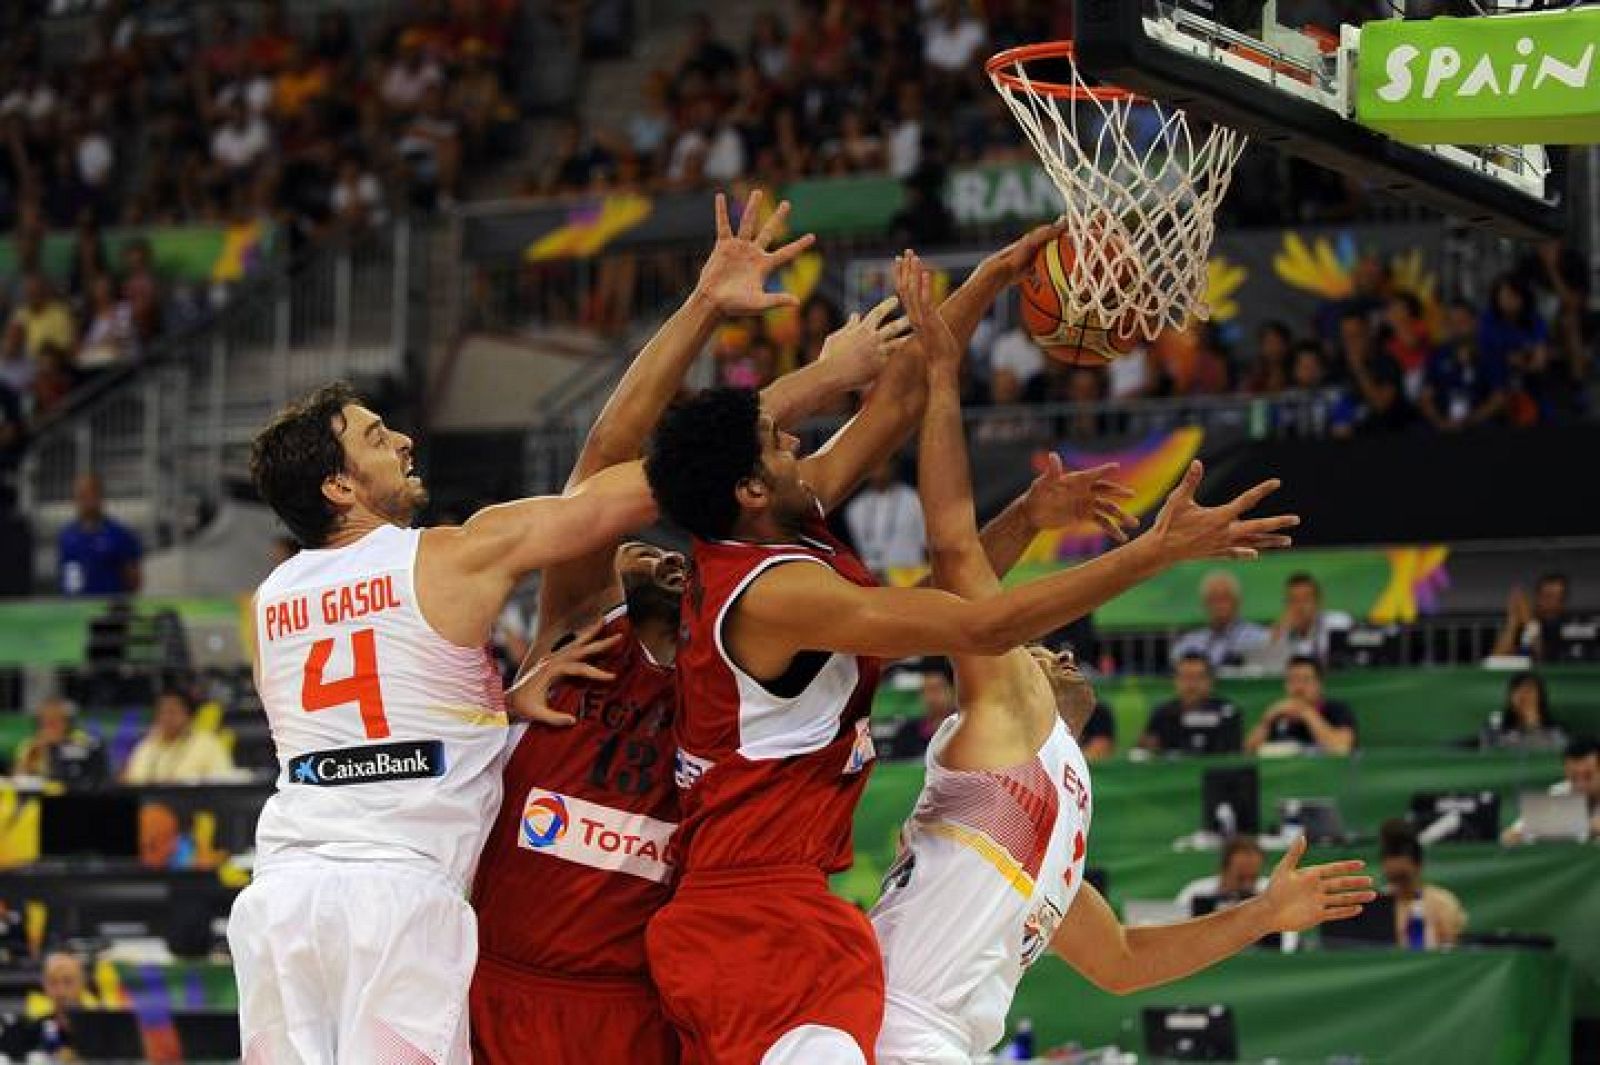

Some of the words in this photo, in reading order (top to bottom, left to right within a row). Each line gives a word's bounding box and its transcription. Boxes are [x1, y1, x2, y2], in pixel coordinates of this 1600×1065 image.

[265, 596, 310, 641] PAU
[321, 575, 401, 625] GASOL
[301, 628, 392, 739] 4
[317, 749, 430, 781] CaixaBank
[590, 733, 659, 795] 13
